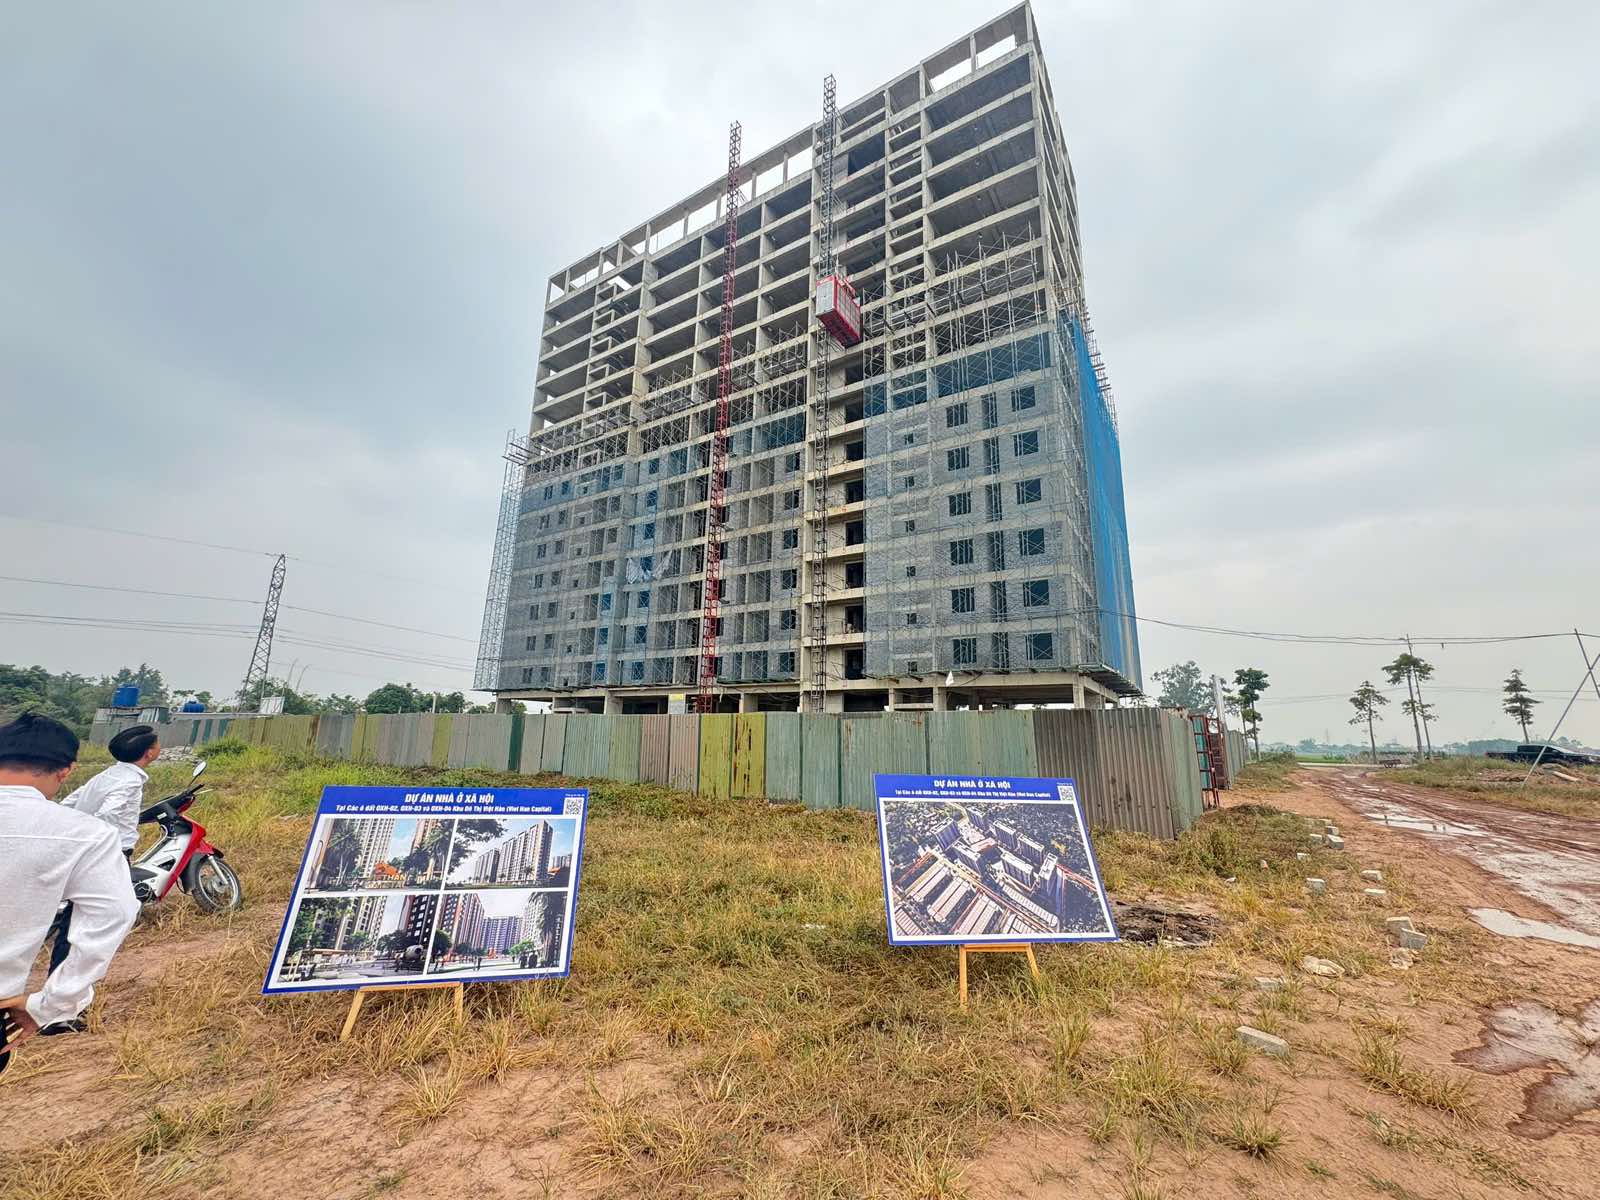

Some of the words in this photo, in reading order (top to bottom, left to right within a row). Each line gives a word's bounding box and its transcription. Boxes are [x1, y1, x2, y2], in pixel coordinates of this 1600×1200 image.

[934, 780, 945, 789] DỰ
[946, 779, 958, 788] ÁN
[959, 779, 976, 788] NHÀ
[985, 780, 996, 788] XÃ
[997, 780, 1011, 789] HỘI
[404, 793, 420, 804] DỰ
[420, 792, 433, 803] ÁN
[435, 792, 454, 803] NHÀ
[456, 791, 463, 803] Ở
[464, 792, 477, 803] XÃ
[478, 792, 495, 805] HỘI
